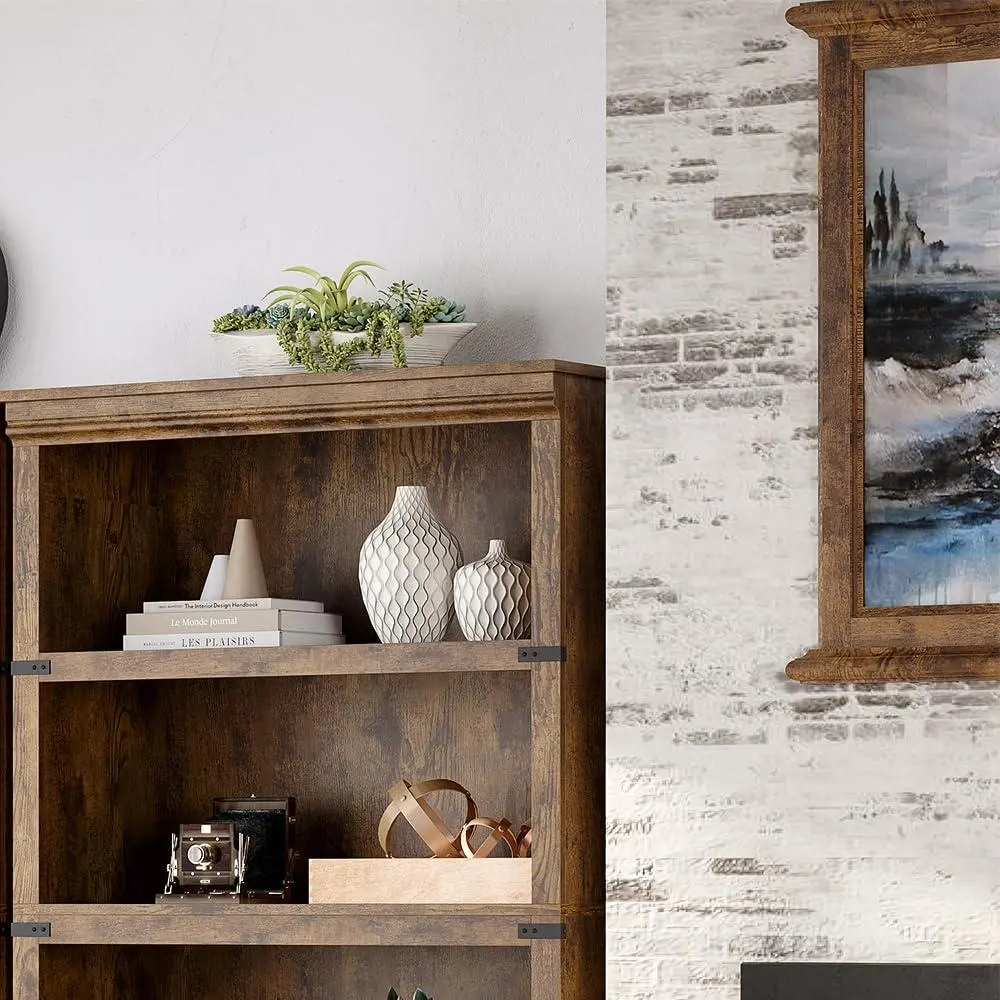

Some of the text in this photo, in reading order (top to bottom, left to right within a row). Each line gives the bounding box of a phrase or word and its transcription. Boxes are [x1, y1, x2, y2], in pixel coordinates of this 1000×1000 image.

[214, 602, 230, 610] Design
[171, 616, 238, 628] Le Monde Journal
[182, 638, 200, 648] LES
[205, 636, 255, 647] PLAISIRS
